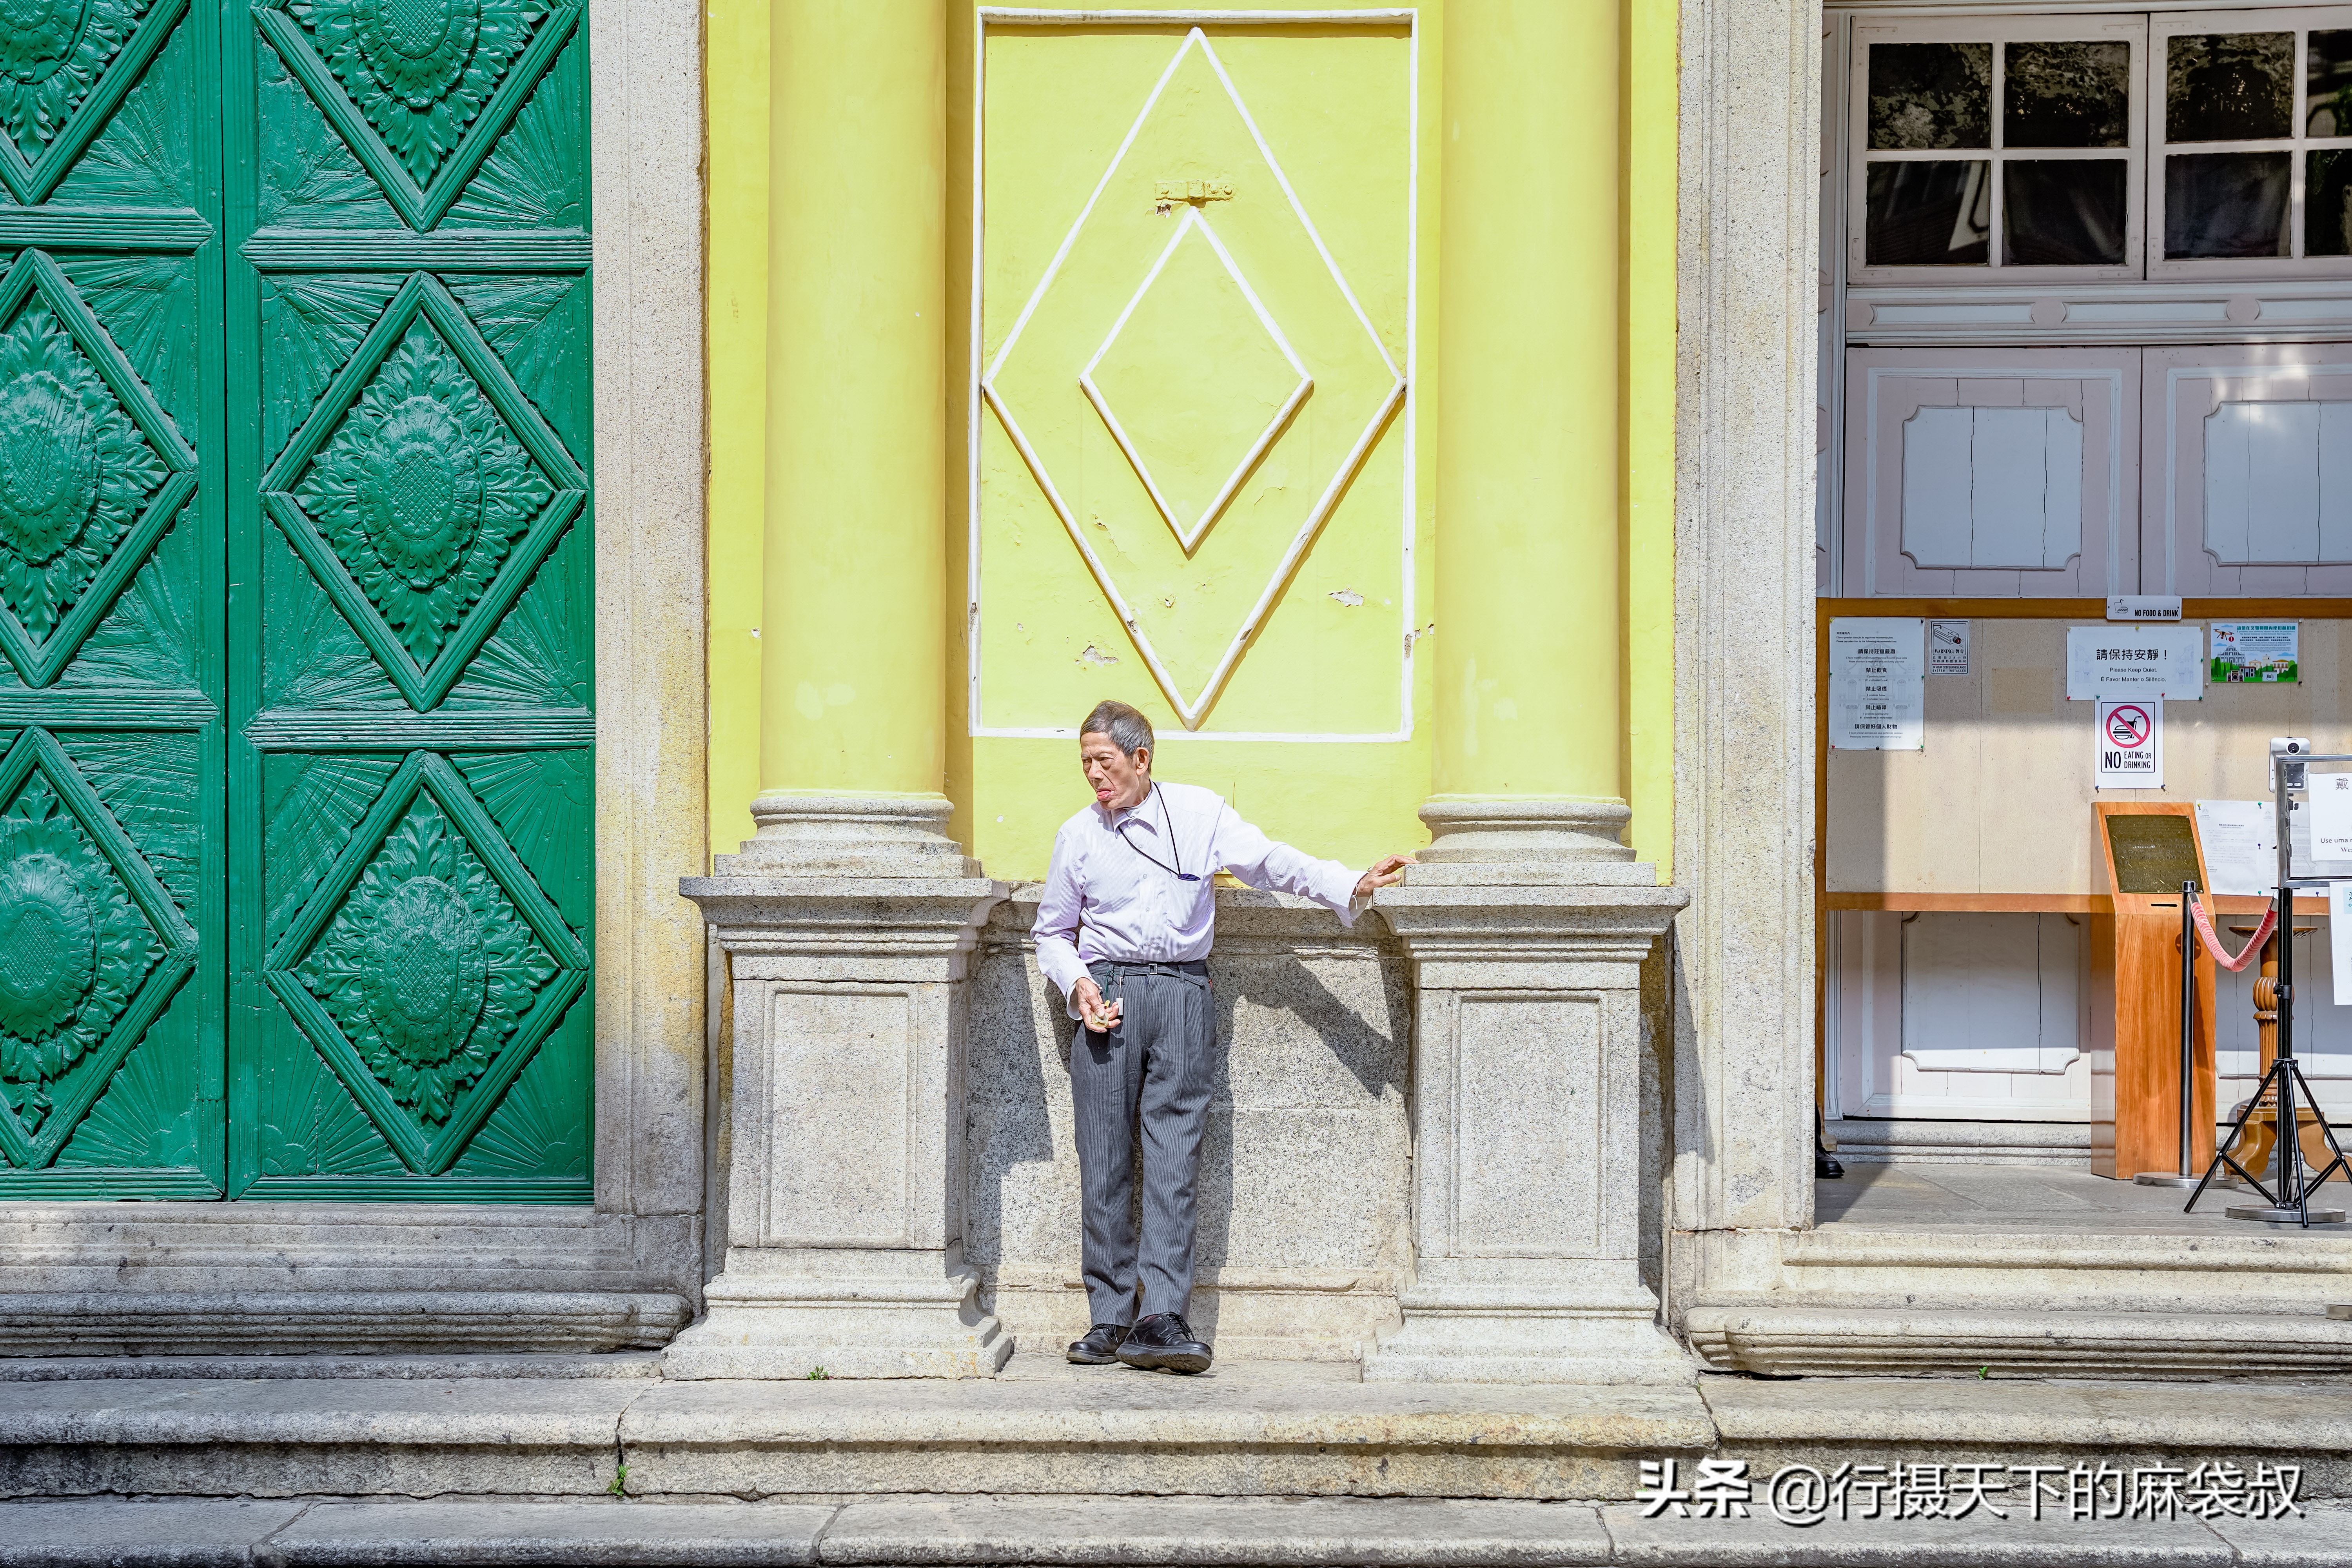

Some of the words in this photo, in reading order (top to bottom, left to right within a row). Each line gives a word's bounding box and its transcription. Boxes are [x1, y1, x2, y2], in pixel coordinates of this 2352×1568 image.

[2096, 649, 2167, 660] 請保持安靜！
[2105, 751, 2121, 768] NO
[2335, 778, 2349, 790] 戴
